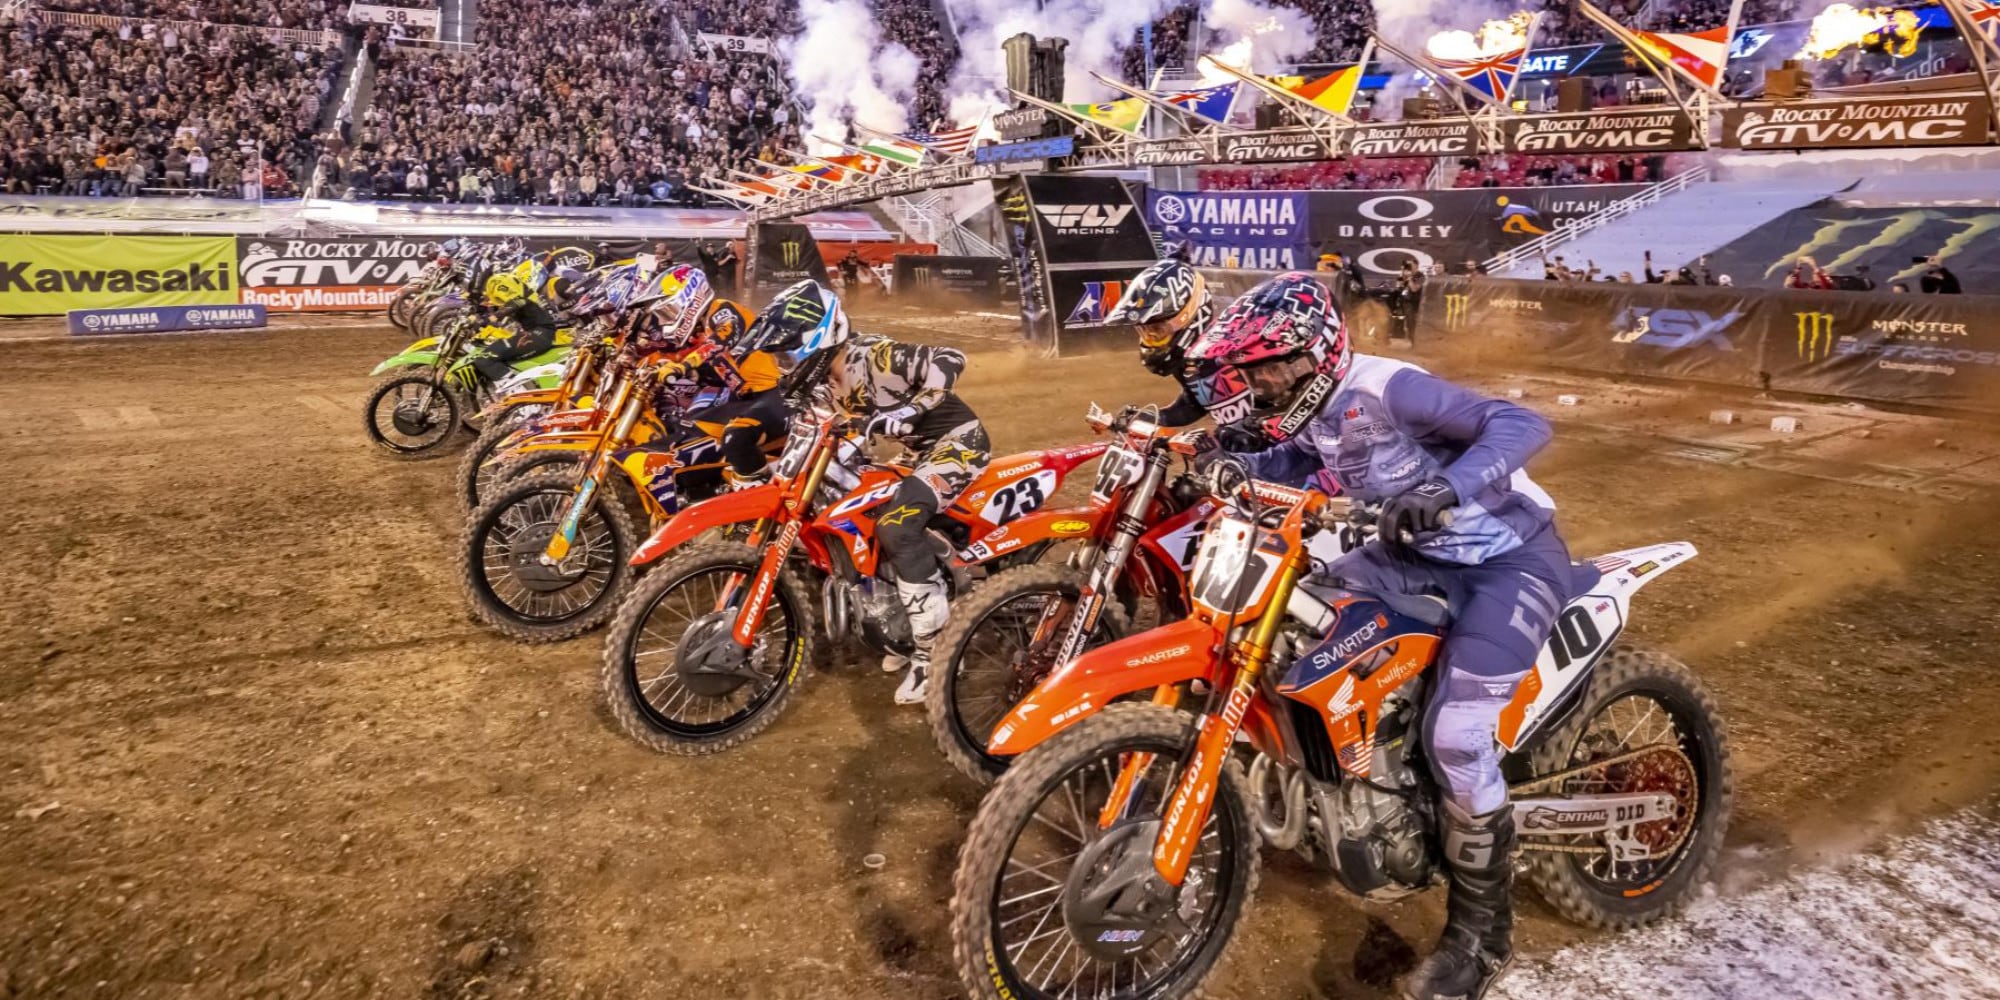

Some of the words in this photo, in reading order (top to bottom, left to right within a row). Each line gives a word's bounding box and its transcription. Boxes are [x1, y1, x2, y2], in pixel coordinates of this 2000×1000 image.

[386, 10, 407, 23] 38
[727, 38, 745, 50] 39
[1768, 108, 1837, 123] ROCKY
[1840, 102, 1969, 120] MOUNTAIN
[1369, 128, 1404, 139] ROCKY
[1404, 125, 1469, 138] MOUNTAIN
[1538, 119, 1586, 132] ROCKY
[1587, 114, 1676, 130] MOUNTAIN
[1189, 198, 1296, 225] YAMAHA
[1552, 201, 1600, 213] UTAH
[1056, 227, 1116, 236] RACING
[1166, 225, 1288, 236] RACING
[1339, 225, 1453, 239] OAKLEY
[284, 239, 362, 259] ROCKY
[0, 261, 229, 295] Kawasaki
[101, 312, 160, 327] YAMAHA
[201, 308, 256, 321] YAMAHA
[1871, 319, 1968, 337] MONSTER
[996, 461, 1043, 479] HONDA
[1094, 449, 1141, 498] 95
[991, 476, 1045, 526] 23
[741, 571, 770, 637] DUNLOP
[1548, 604, 1602, 672] 10
[1330, 699, 1364, 724] HONDA
[1163, 751, 1204, 843] DUNLOP
[1615, 803, 1645, 822] DID
